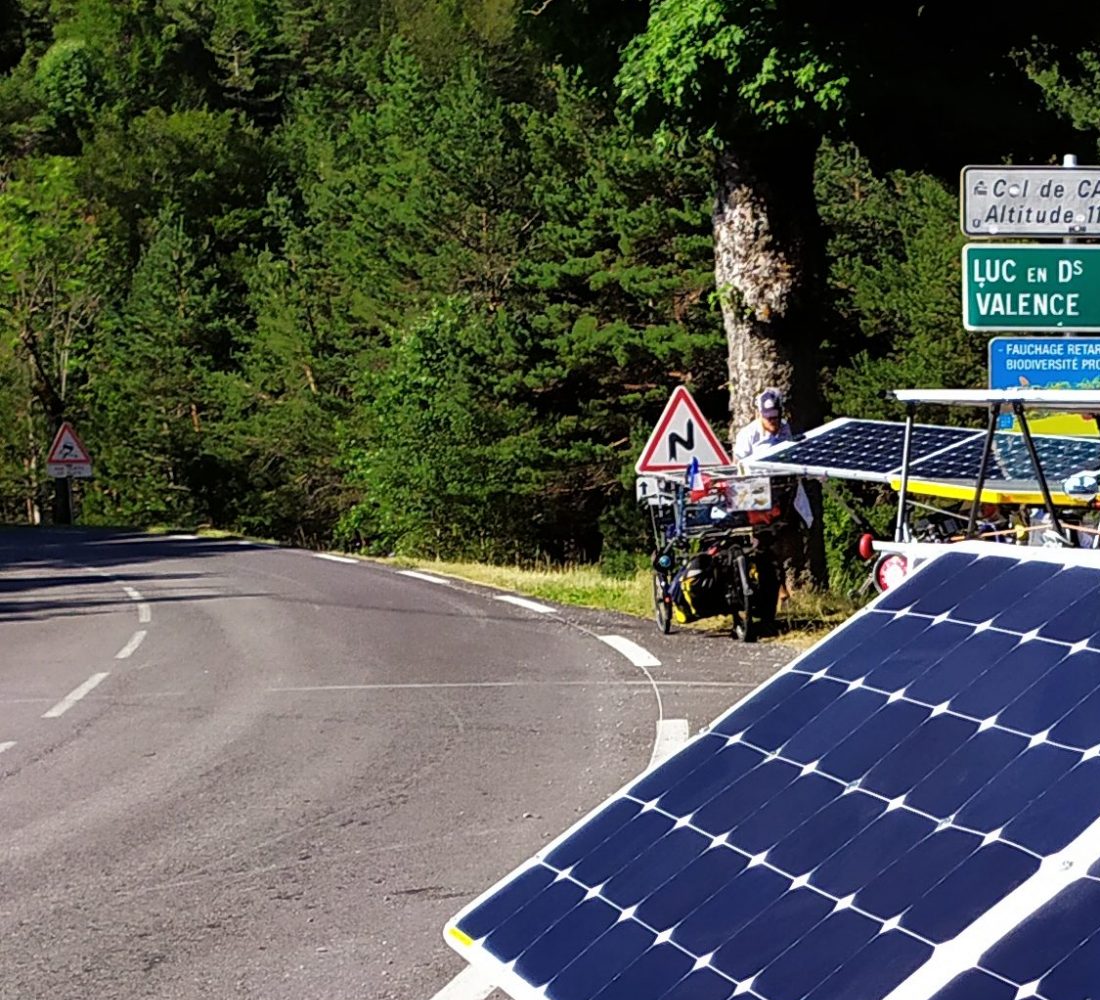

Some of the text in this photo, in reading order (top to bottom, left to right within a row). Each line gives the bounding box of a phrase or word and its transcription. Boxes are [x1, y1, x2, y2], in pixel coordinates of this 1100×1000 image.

[1040, 179, 1065, 199] de
[985, 205, 1074, 224] Altitude
[973, 259, 1016, 283] LUC
[1027, 268, 1047, 283] EN
[976, 293, 1080, 316] VALENCE
[1006, 343, 1064, 355] FAUCHAGE
[1006, 357, 1078, 370] BIODIVERSITÉ
